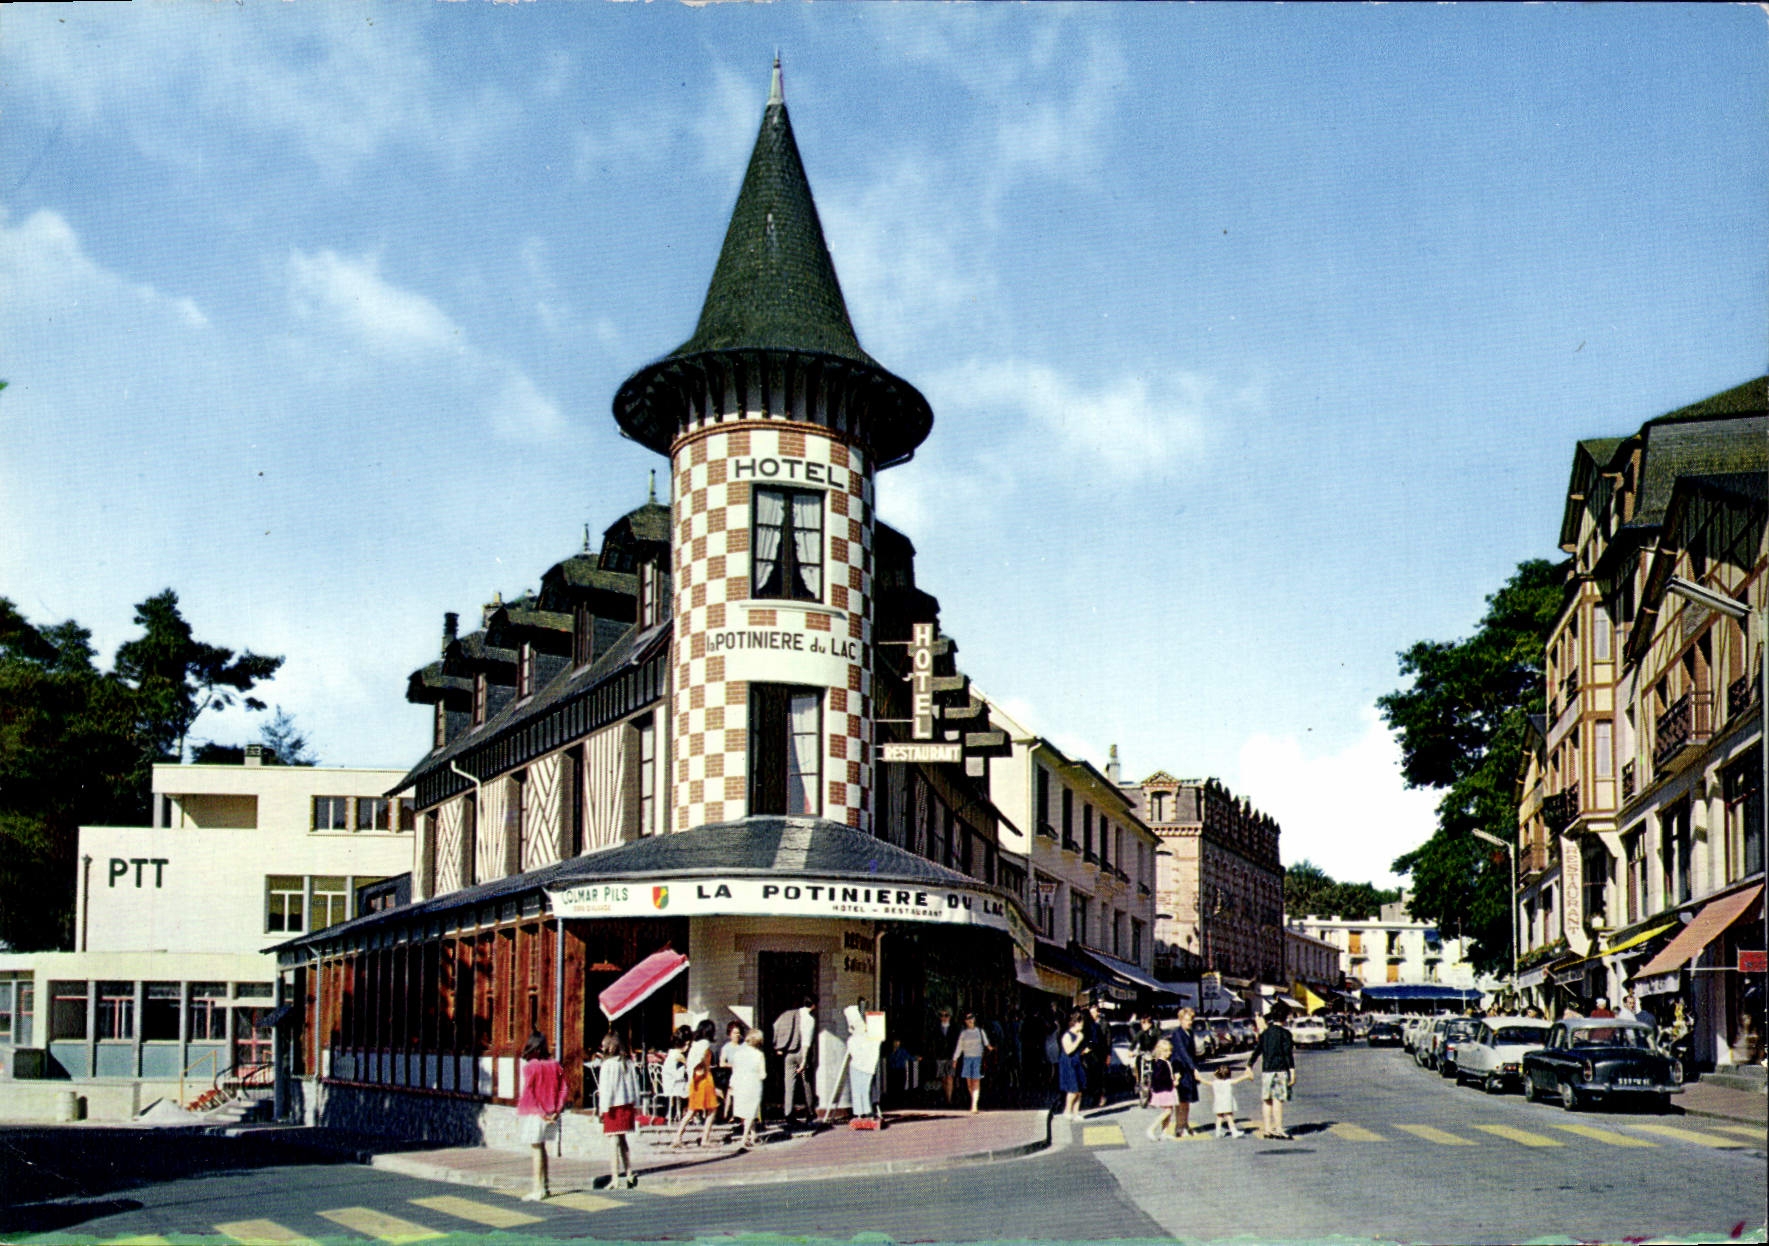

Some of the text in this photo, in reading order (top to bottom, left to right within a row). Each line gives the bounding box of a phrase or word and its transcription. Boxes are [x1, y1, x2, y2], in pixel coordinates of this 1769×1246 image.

[734, 457, 845, 489] HOTEL
[715, 631, 804, 651] POTINIERE
[809, 636, 826, 654] du
[831, 637, 857, 661] LAC
[914, 624, 932, 739] HOTEL
[884, 745, 962, 762] RESTAURANT
[108, 857, 169, 889] PTT
[561, 888, 599, 905] COLMAR
[696, 884, 732, 899] LA
[762, 884, 929, 907] POTINIERE
[946, 893, 972, 910] DU
[1566, 845, 1580, 935] RESTAURANT
